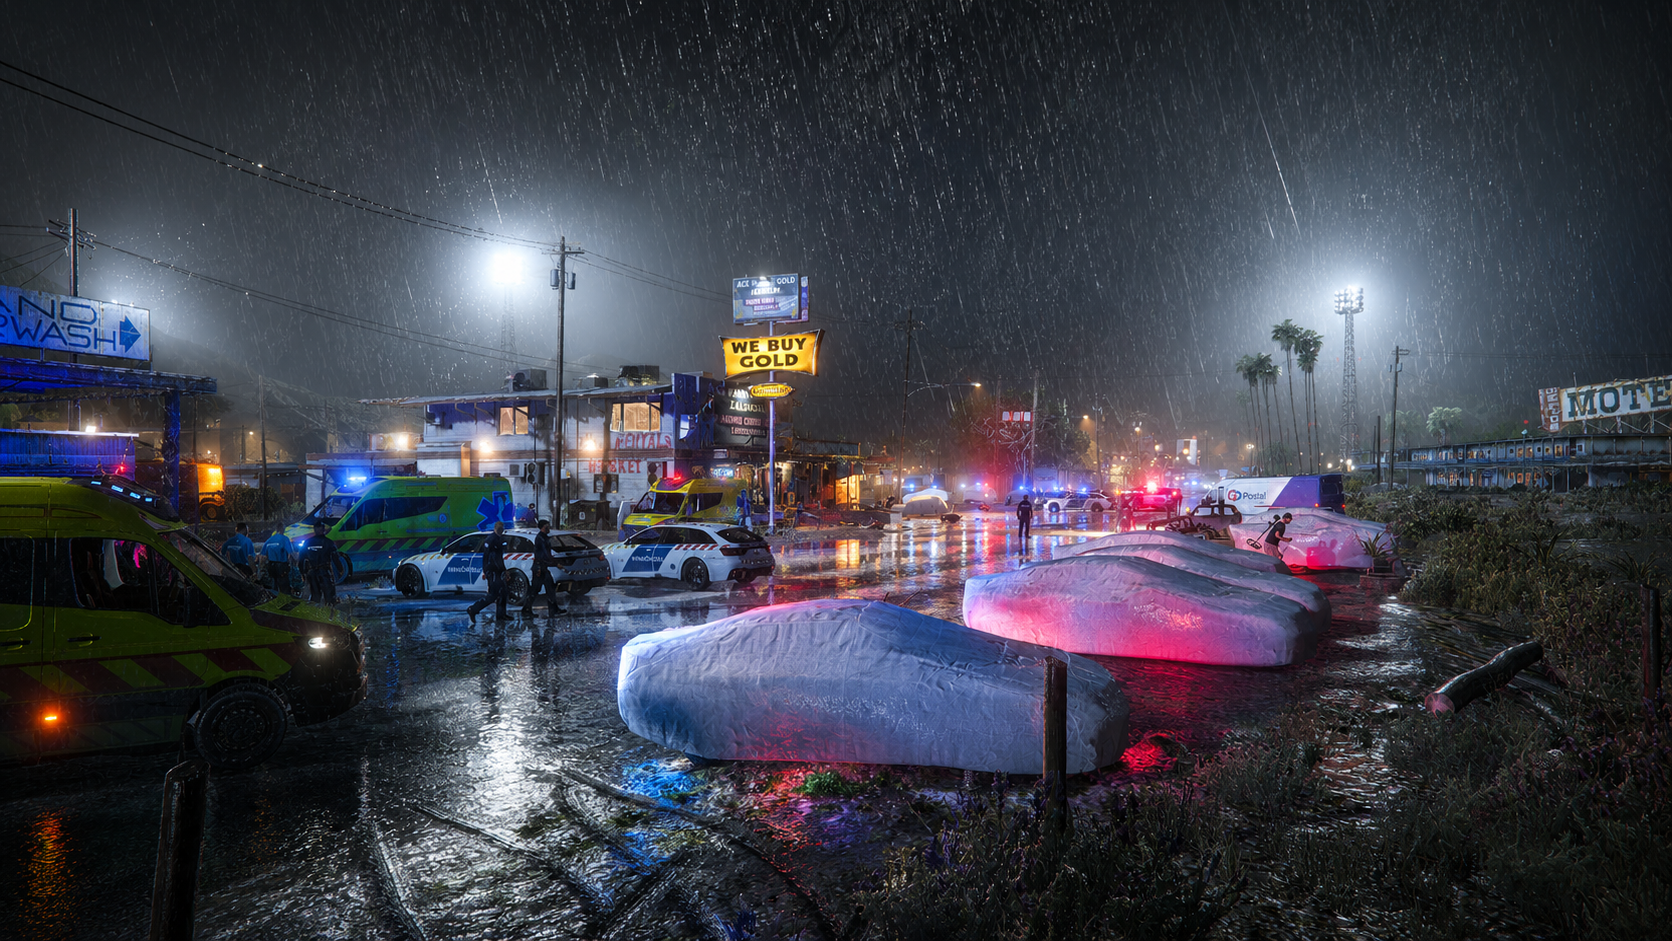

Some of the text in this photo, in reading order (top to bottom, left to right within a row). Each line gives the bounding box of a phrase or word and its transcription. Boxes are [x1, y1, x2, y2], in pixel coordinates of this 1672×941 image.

[731, 337, 807, 354] WE BUY
[739, 353, 799, 368] GOLD
[1242, 491, 1267, 500] Postal
